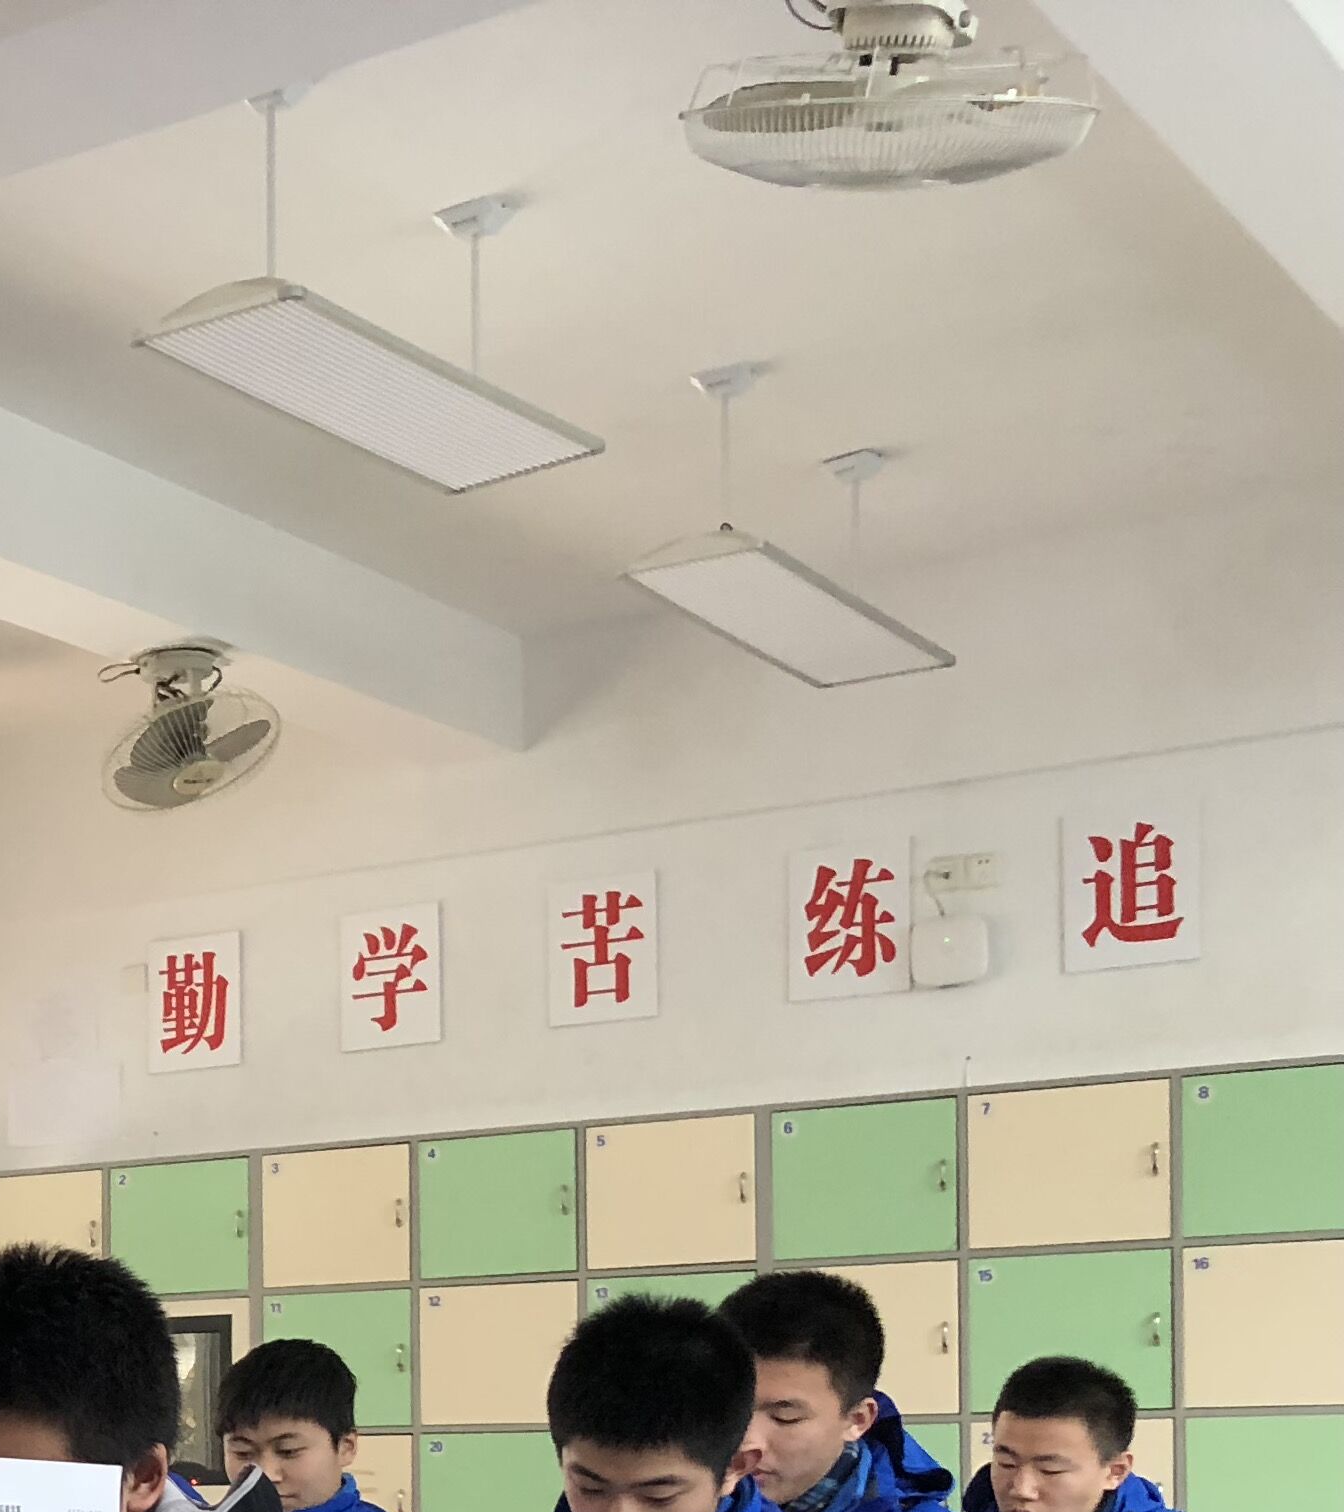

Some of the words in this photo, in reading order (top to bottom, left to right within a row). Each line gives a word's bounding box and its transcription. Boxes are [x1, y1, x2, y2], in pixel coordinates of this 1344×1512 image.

[1198, 1086, 1210, 1099] 8
[982, 1102, 991, 1115] 7
[783, 1122, 793, 1134] 6
[596, 1135, 606, 1147] 5
[427, 1148, 436, 1159] 4
[271, 1163, 280, 1175] 3
[118, 1174, 127, 1185] 2
[1192, 1257, 1209, 1270] 16
[978, 1269, 993, 1281] 15
[595, 1287, 609, 1299] 13
[428, 1296, 441, 1307] 12
[429, 1441, 443, 1453] 20
